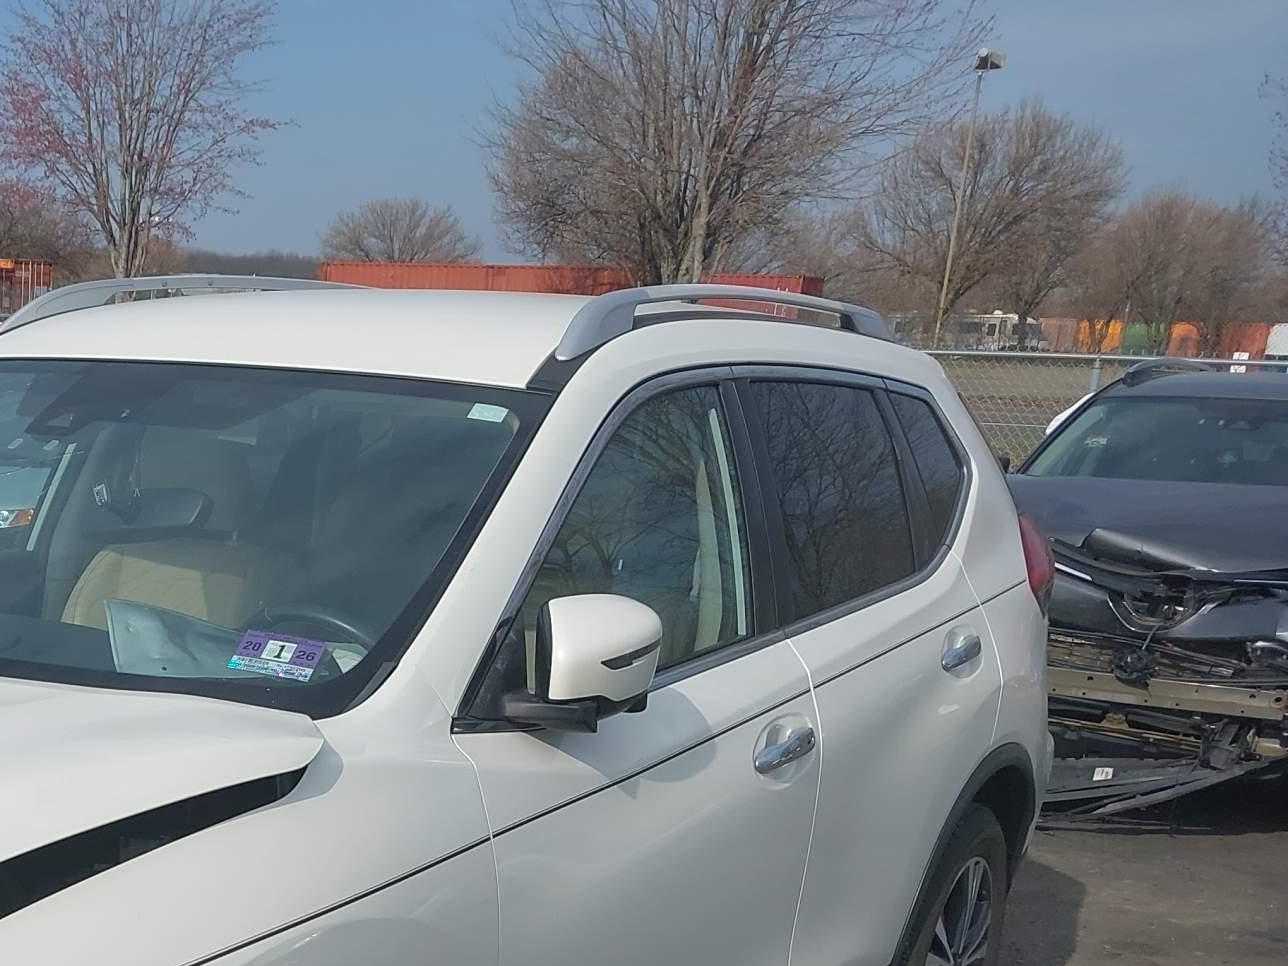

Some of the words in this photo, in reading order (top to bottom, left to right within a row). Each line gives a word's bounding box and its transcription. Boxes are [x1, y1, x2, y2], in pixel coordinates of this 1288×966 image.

[243, 640, 262, 652] 20
[273, 644, 286, 659] 1
[296, 650, 316, 662] 26
